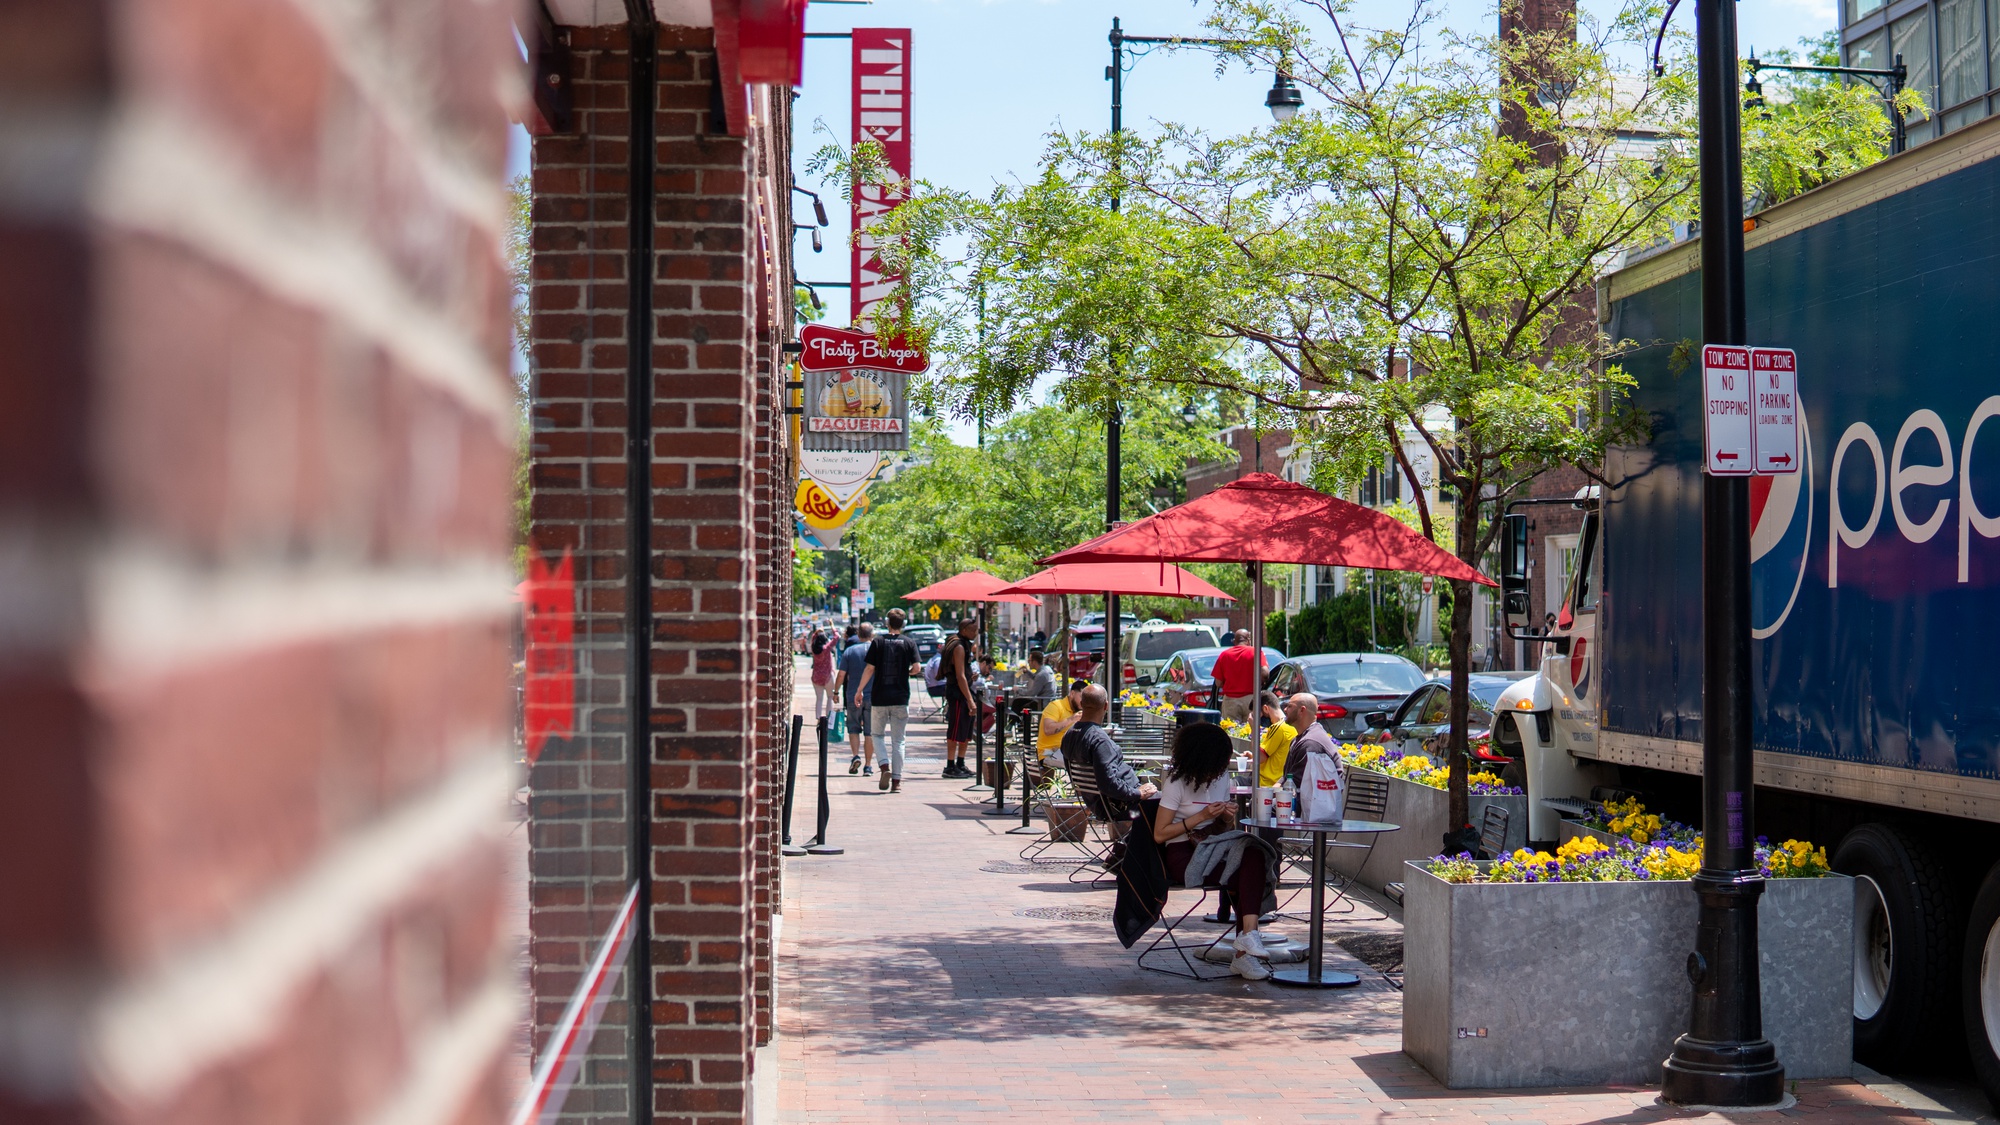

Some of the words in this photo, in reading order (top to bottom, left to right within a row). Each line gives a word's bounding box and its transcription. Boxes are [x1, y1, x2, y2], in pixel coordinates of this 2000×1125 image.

[860, 39, 903, 142] THE
[810, 338, 859, 364] Tasty
[1708, 351, 1724, 365] TOW
[1727, 352, 1746, 366] ZONE
[1755, 354, 1771, 368] TOW
[1773, 355, 1792, 369] ZONE
[826, 377, 839, 389] EL
[1722, 375, 1734, 391] NO
[1769, 374, 1780, 389] NO
[1710, 400, 1748, 415] STOPPING
[1760, 393, 1791, 409] PARKING
[811, 418, 900, 431] TAQUERIA
[1759, 414, 1778, 425] LOADING
[1781, 414, 1793, 425] ZONE
